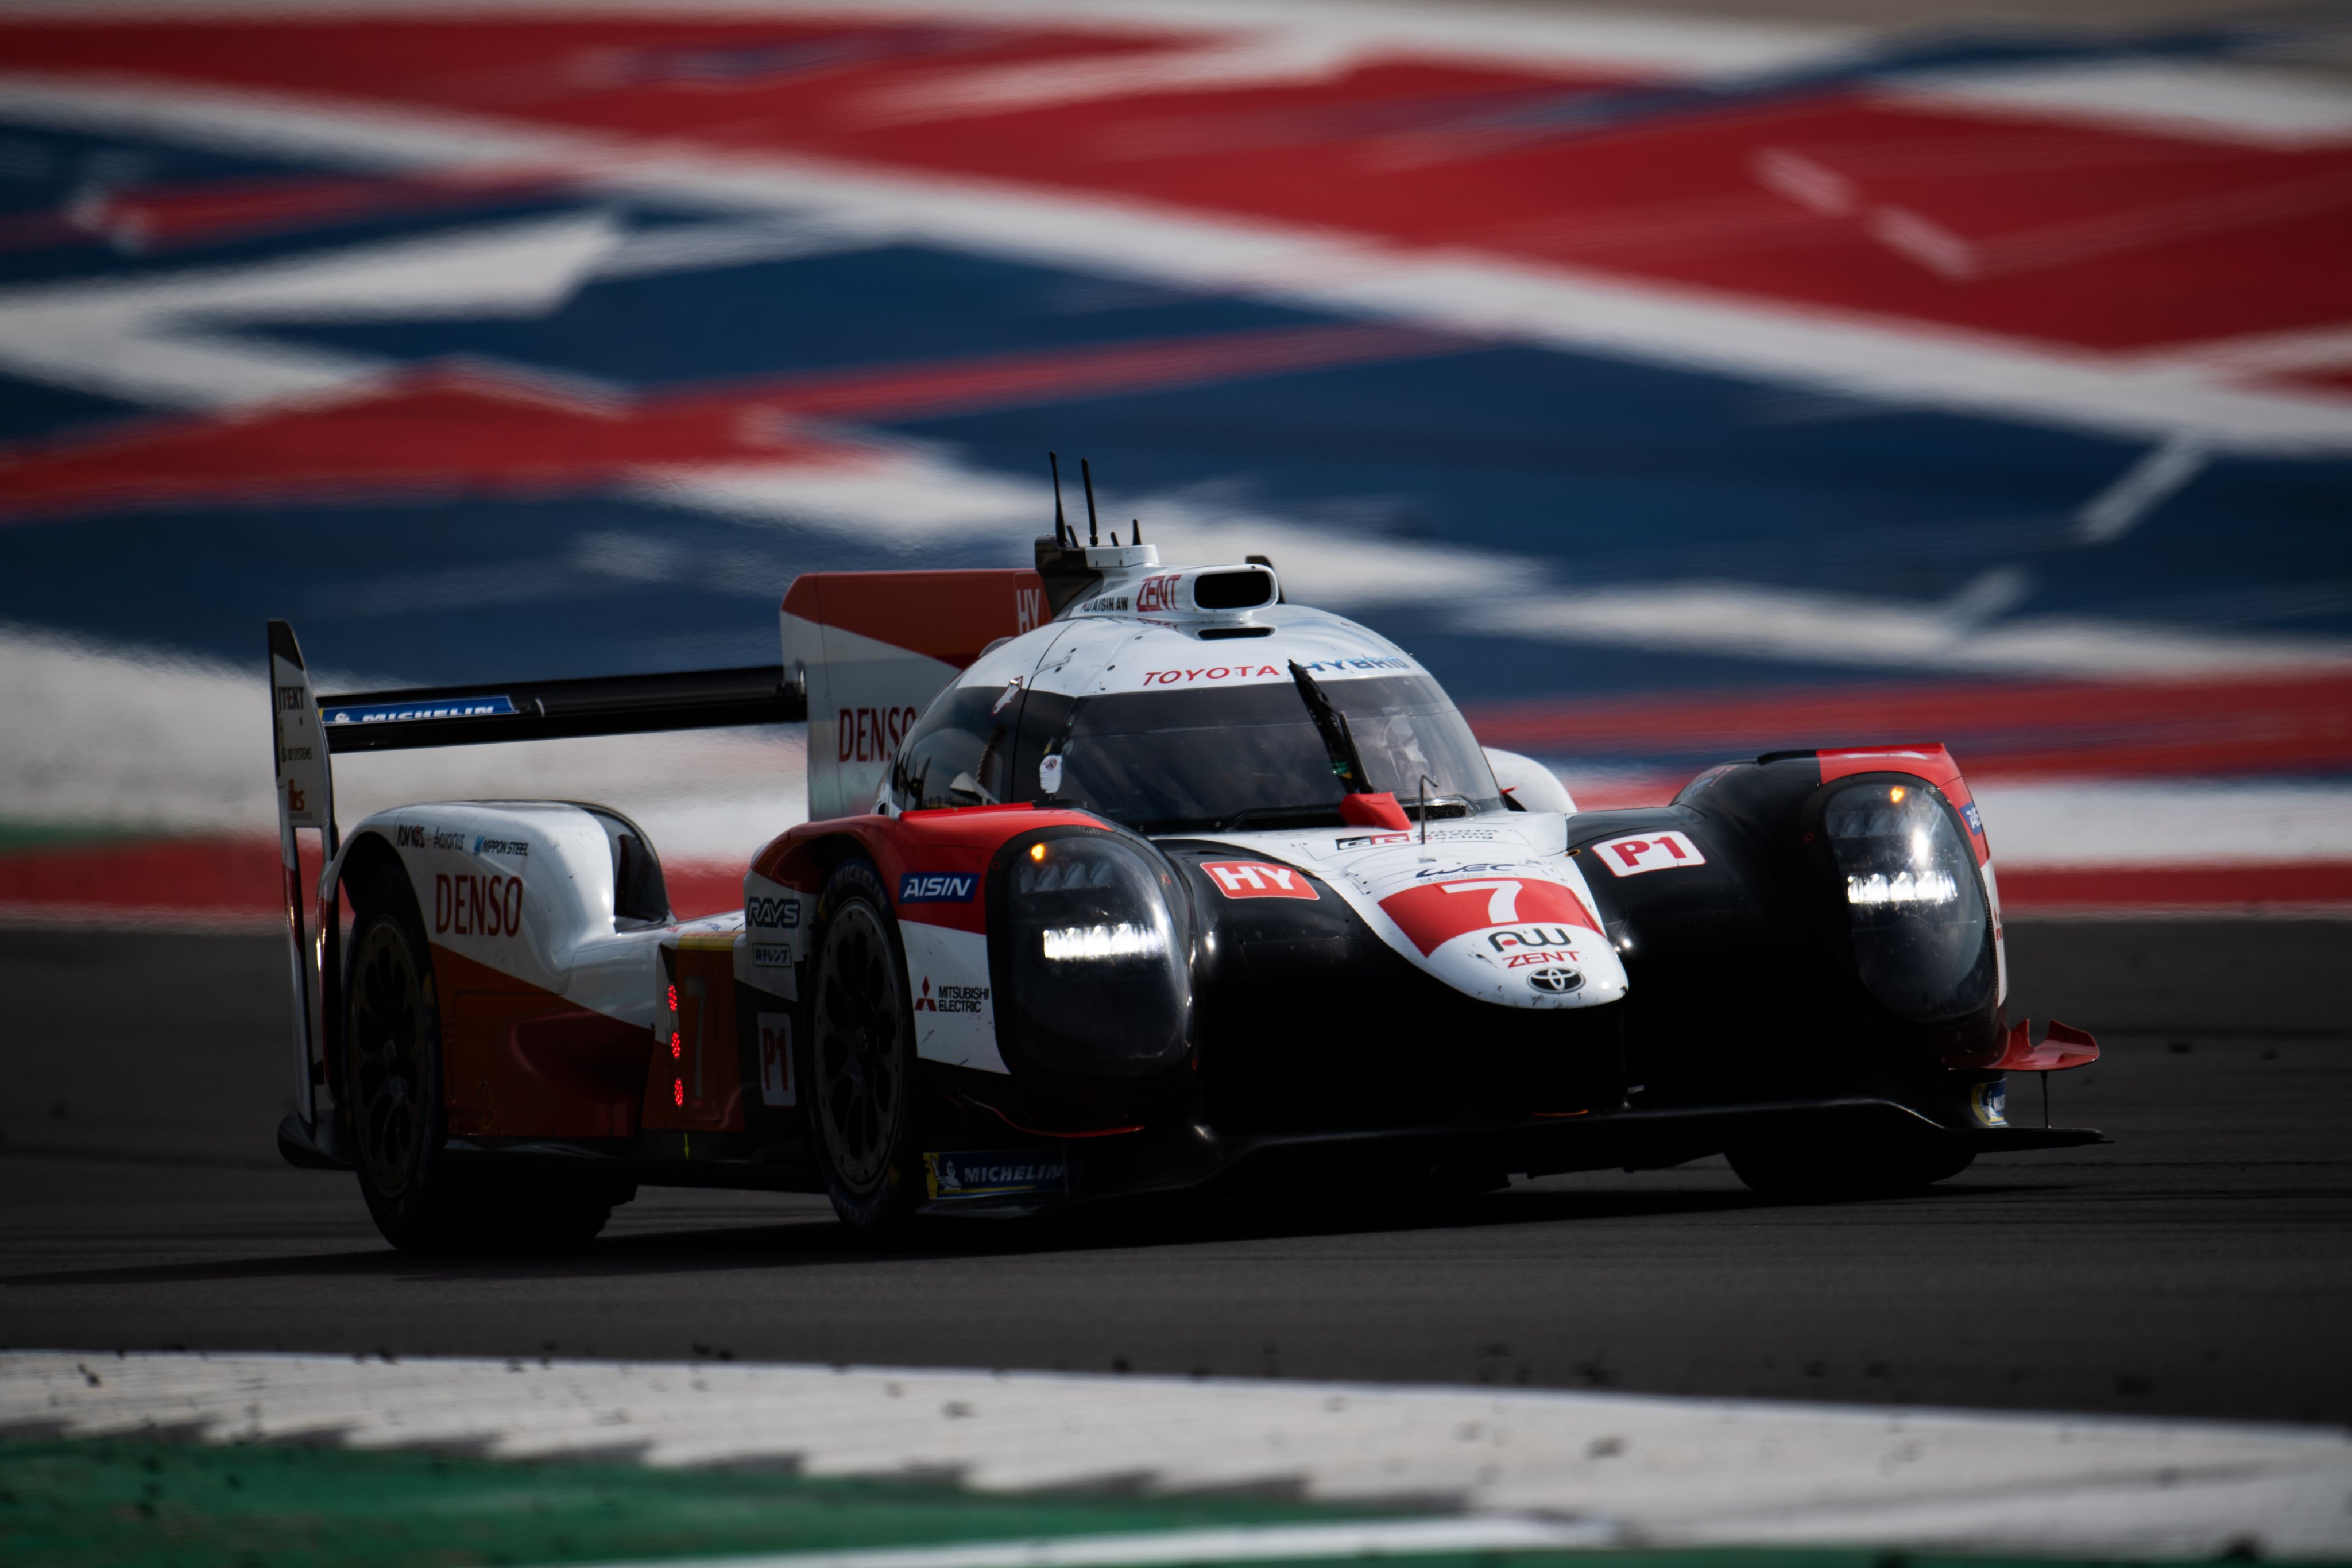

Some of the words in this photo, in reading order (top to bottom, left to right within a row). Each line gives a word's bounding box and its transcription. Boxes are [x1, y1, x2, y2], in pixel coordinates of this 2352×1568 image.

[1091, 597, 1115, 612] AISIN
[1116, 596, 1129, 611] AW
[1136, 574, 1182, 612] ZENT
[1016, 588, 1040, 634] HY
[1143, 665, 1281, 686] TOYOTA
[1297, 656, 1410, 672] HYBRID
[277, 687, 304, 715] JTEKT
[362, 706, 494, 722] MICHELIN
[434, 826, 465, 850] Acronis
[482, 839, 506, 854] NIPPON
[506, 841, 529, 856] STEEL
[1610, 836, 1687, 868] P1
[1212, 866, 1294, 891] HY
[1415, 863, 1515, 878] WEC
[903, 877, 972, 898] AISIN
[436, 874, 523, 938] DENSO
[746, 897, 800, 929] RAYS
[1440, 880, 1523, 924] 7
[755, 947, 788, 963] 林テレンプ
[1502, 951, 1580, 969] ZENT
[939, 986, 989, 1000] MITSUBISHI
[939, 1000, 981, 1012] ELECTRIC
[684, 976, 707, 1099] 7
[763, 1027, 789, 1091] P1
[963, 1163, 1065, 1183] MICHELIN
